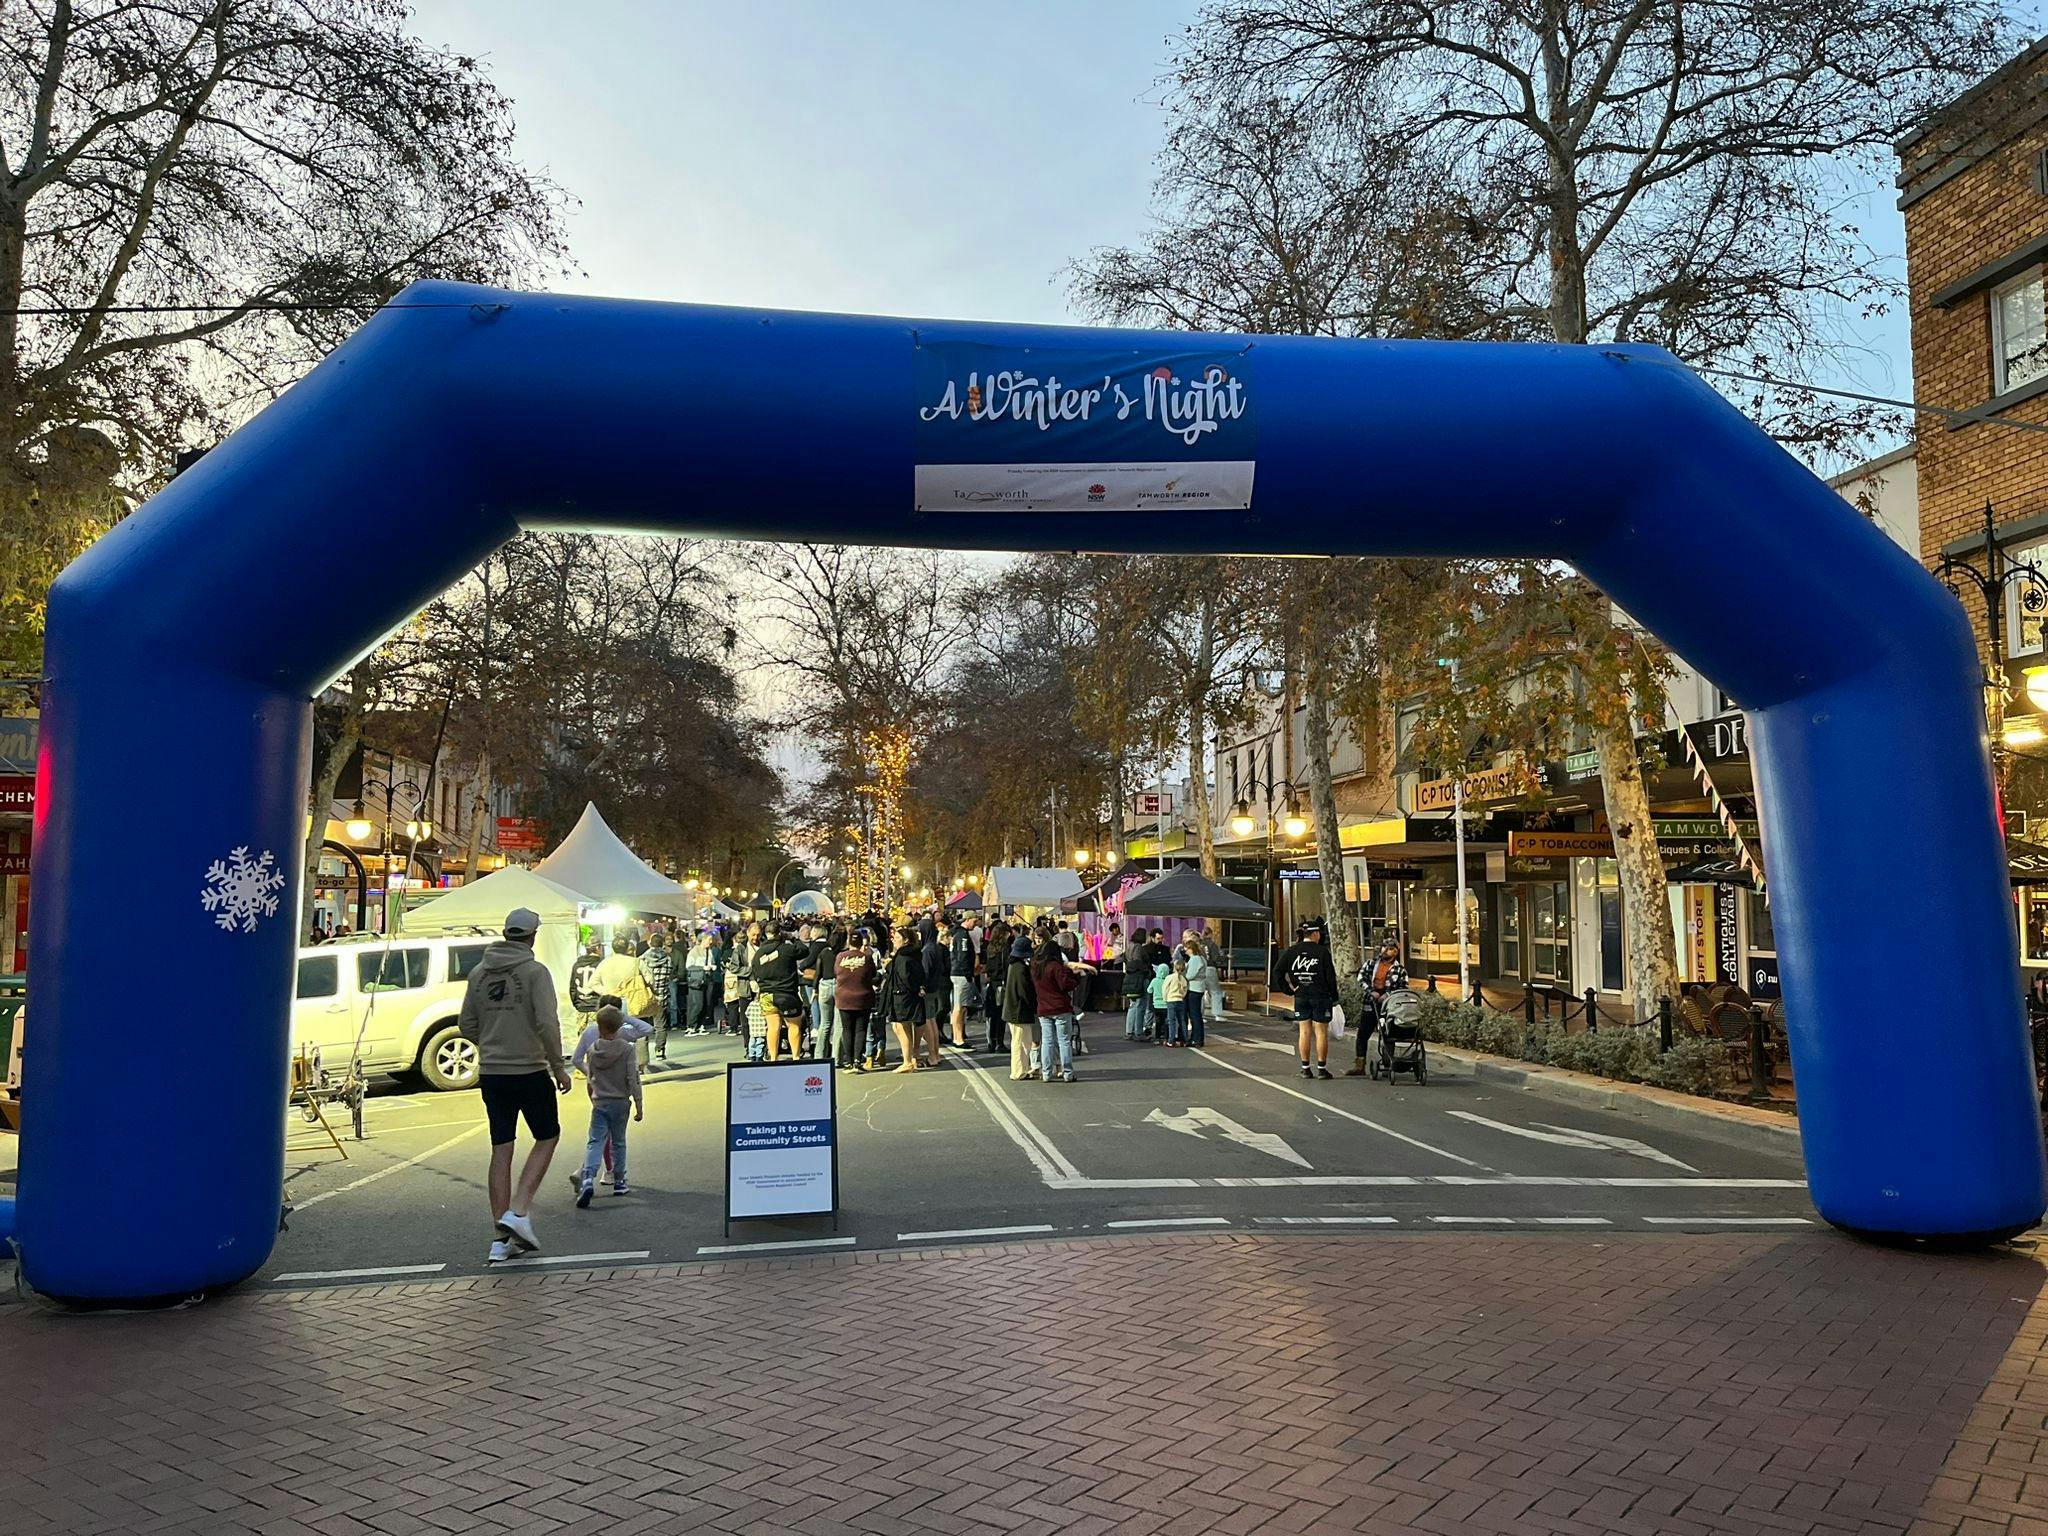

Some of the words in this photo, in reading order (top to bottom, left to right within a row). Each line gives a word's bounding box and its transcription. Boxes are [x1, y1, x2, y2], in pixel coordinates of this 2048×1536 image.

[920, 380, 963, 421] A
[968, 371, 1139, 431] Winter's
[1144, 368, 1247, 445] Night
[1438, 772, 1512, 802] TOBCCONIST
[1693, 844, 1701, 855] &
[1696, 899, 1704, 947] STORE
[1720, 898, 1730, 972] ANTIQUES
[1697, 950, 1705, 982] GIFT
[735, 1136, 790, 1147] Community
[792, 1134, 827, 1143] Streets
[745, 1126, 777, 1135] Taking
[779, 1125, 786, 1134] it
[788, 1125, 798, 1133] to
[800, 1124, 817, 1132] our
